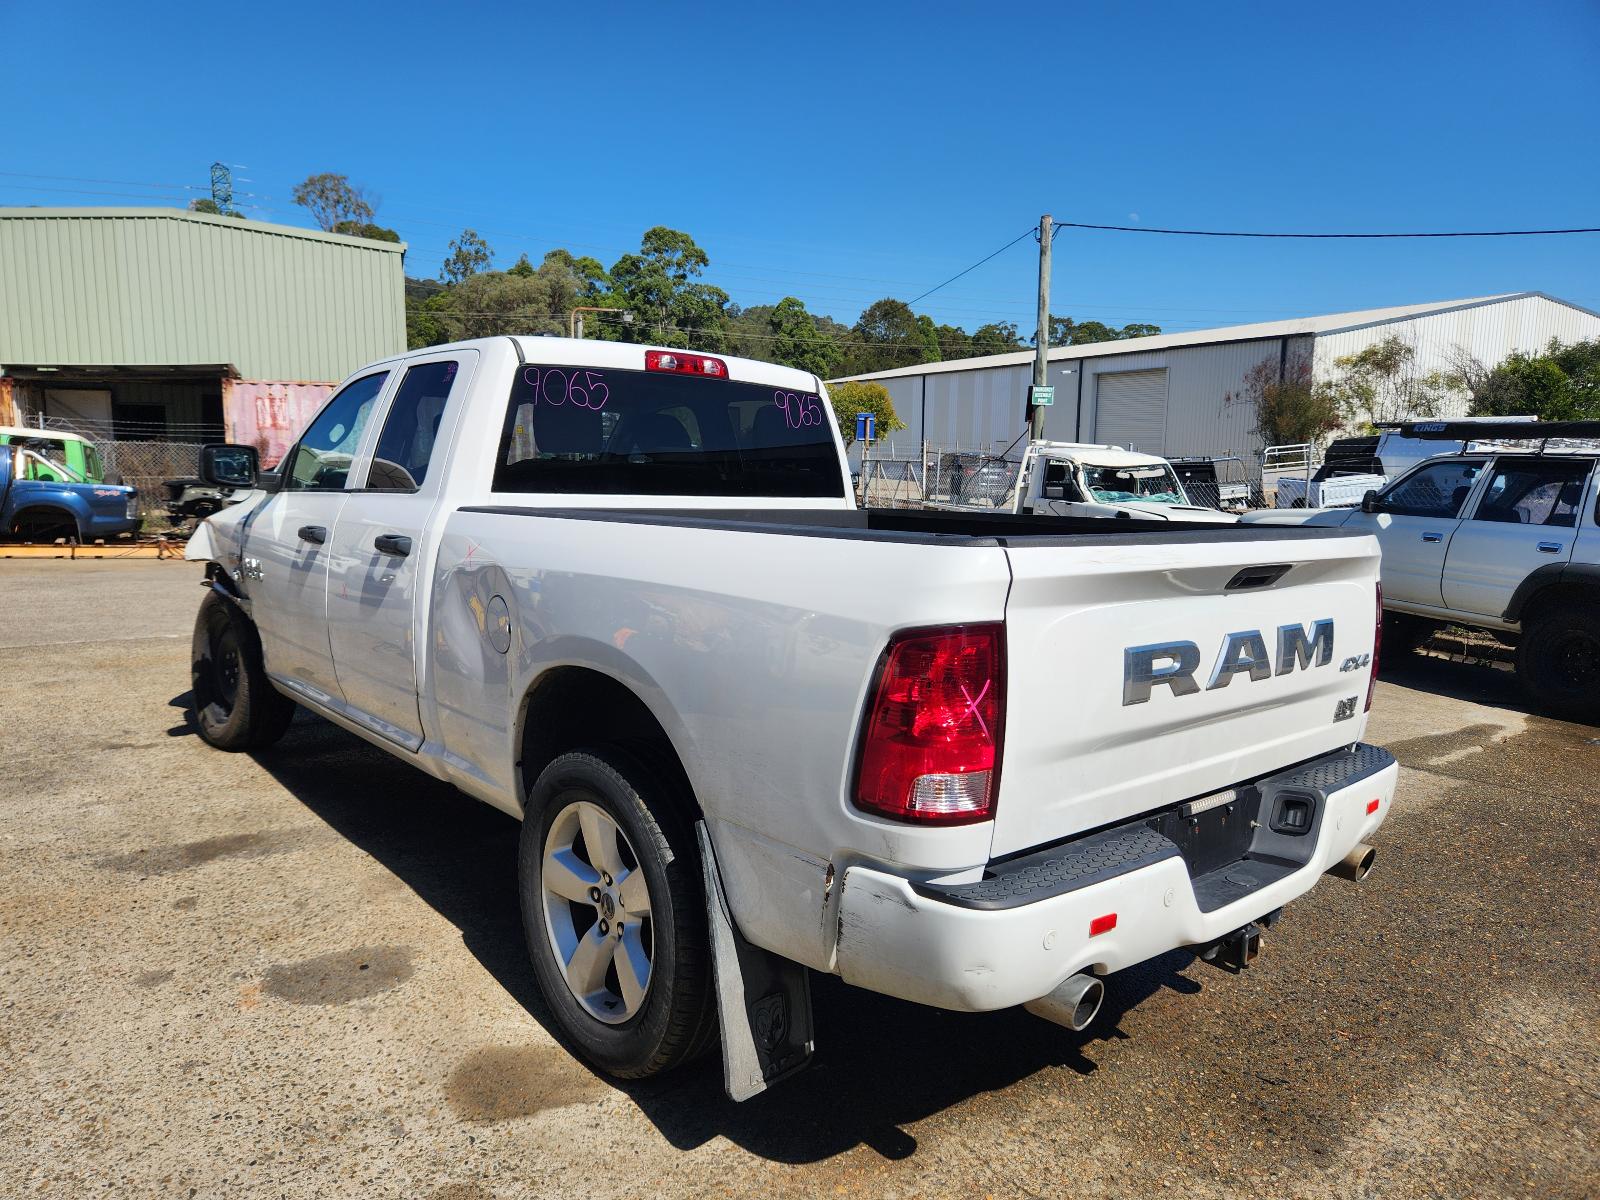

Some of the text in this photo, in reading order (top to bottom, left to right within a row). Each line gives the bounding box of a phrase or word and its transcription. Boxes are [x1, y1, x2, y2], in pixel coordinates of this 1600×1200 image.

[524, 367, 609, 410] 9065
[774, 390, 822, 429] 9065
[1413, 423, 1448, 432] KINGS
[1122, 618, 1334, 706] RAM
